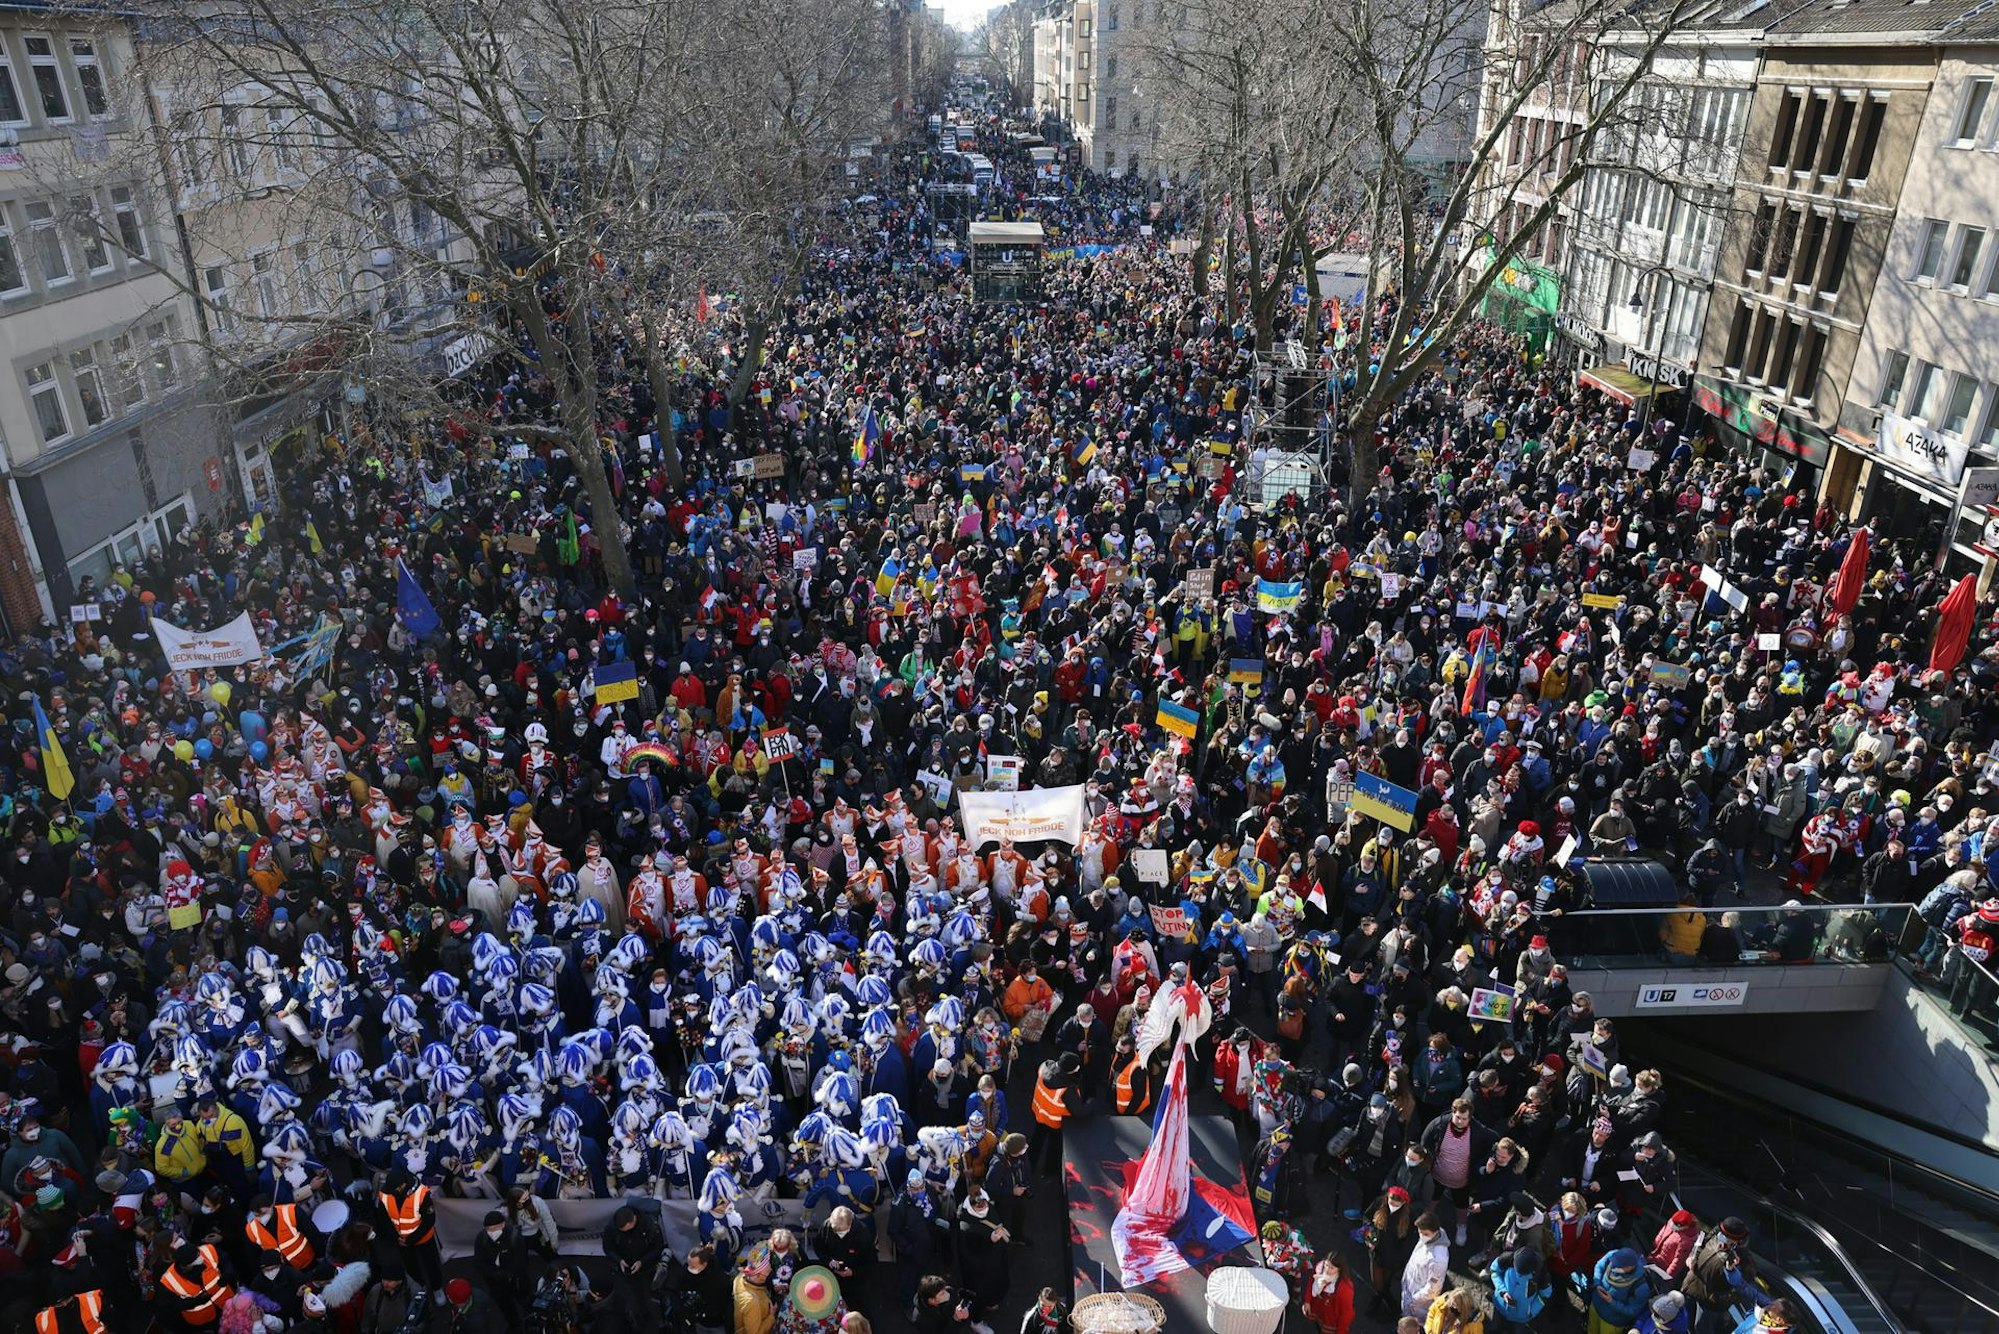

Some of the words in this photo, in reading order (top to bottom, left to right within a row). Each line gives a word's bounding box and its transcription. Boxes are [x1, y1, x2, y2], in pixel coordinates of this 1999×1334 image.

[1002, 251, 1012, 263] U
[1050, 249, 1075, 260] WAR
[1631, 358, 1681, 388] KIOSK
[171, 653, 193, 663] JECK
[213, 649, 243, 661] FRIDDE
[769, 733, 789, 748] FCK
[771, 745, 790, 758] PTN
[977, 827, 1001, 837] JECK
[1004, 827, 1026, 837] NOH
[1028, 821, 1065, 835] FRIDDE
[1152, 907, 1183, 919] STOP
[1153, 918, 1187, 934] PUTIN
[1644, 990, 1660, 1003] U
[1663, 992, 1674, 1001] 17
[1487, 1001, 1506, 1009] NOT
